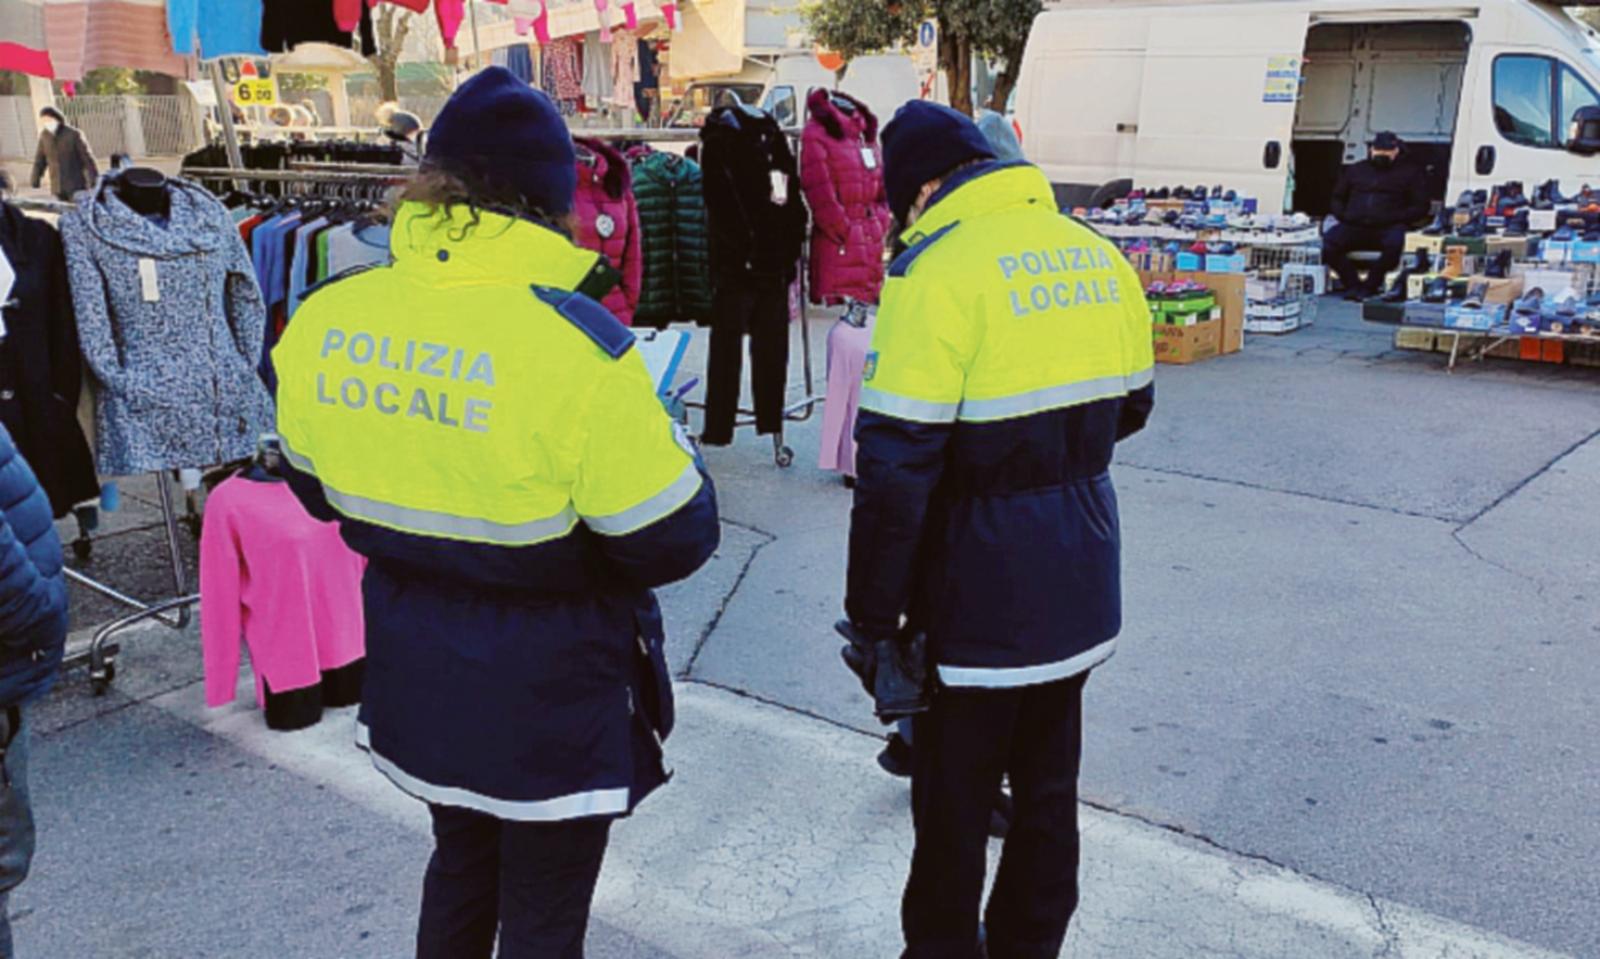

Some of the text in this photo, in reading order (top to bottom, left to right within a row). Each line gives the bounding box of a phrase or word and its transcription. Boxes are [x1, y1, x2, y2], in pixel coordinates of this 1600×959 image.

[998, 246, 1113, 279] POLIZIA
[1009, 277, 1120, 317] LOCALE
[320, 328, 496, 386] POLIZIA
[317, 372, 493, 433] LOCALE
